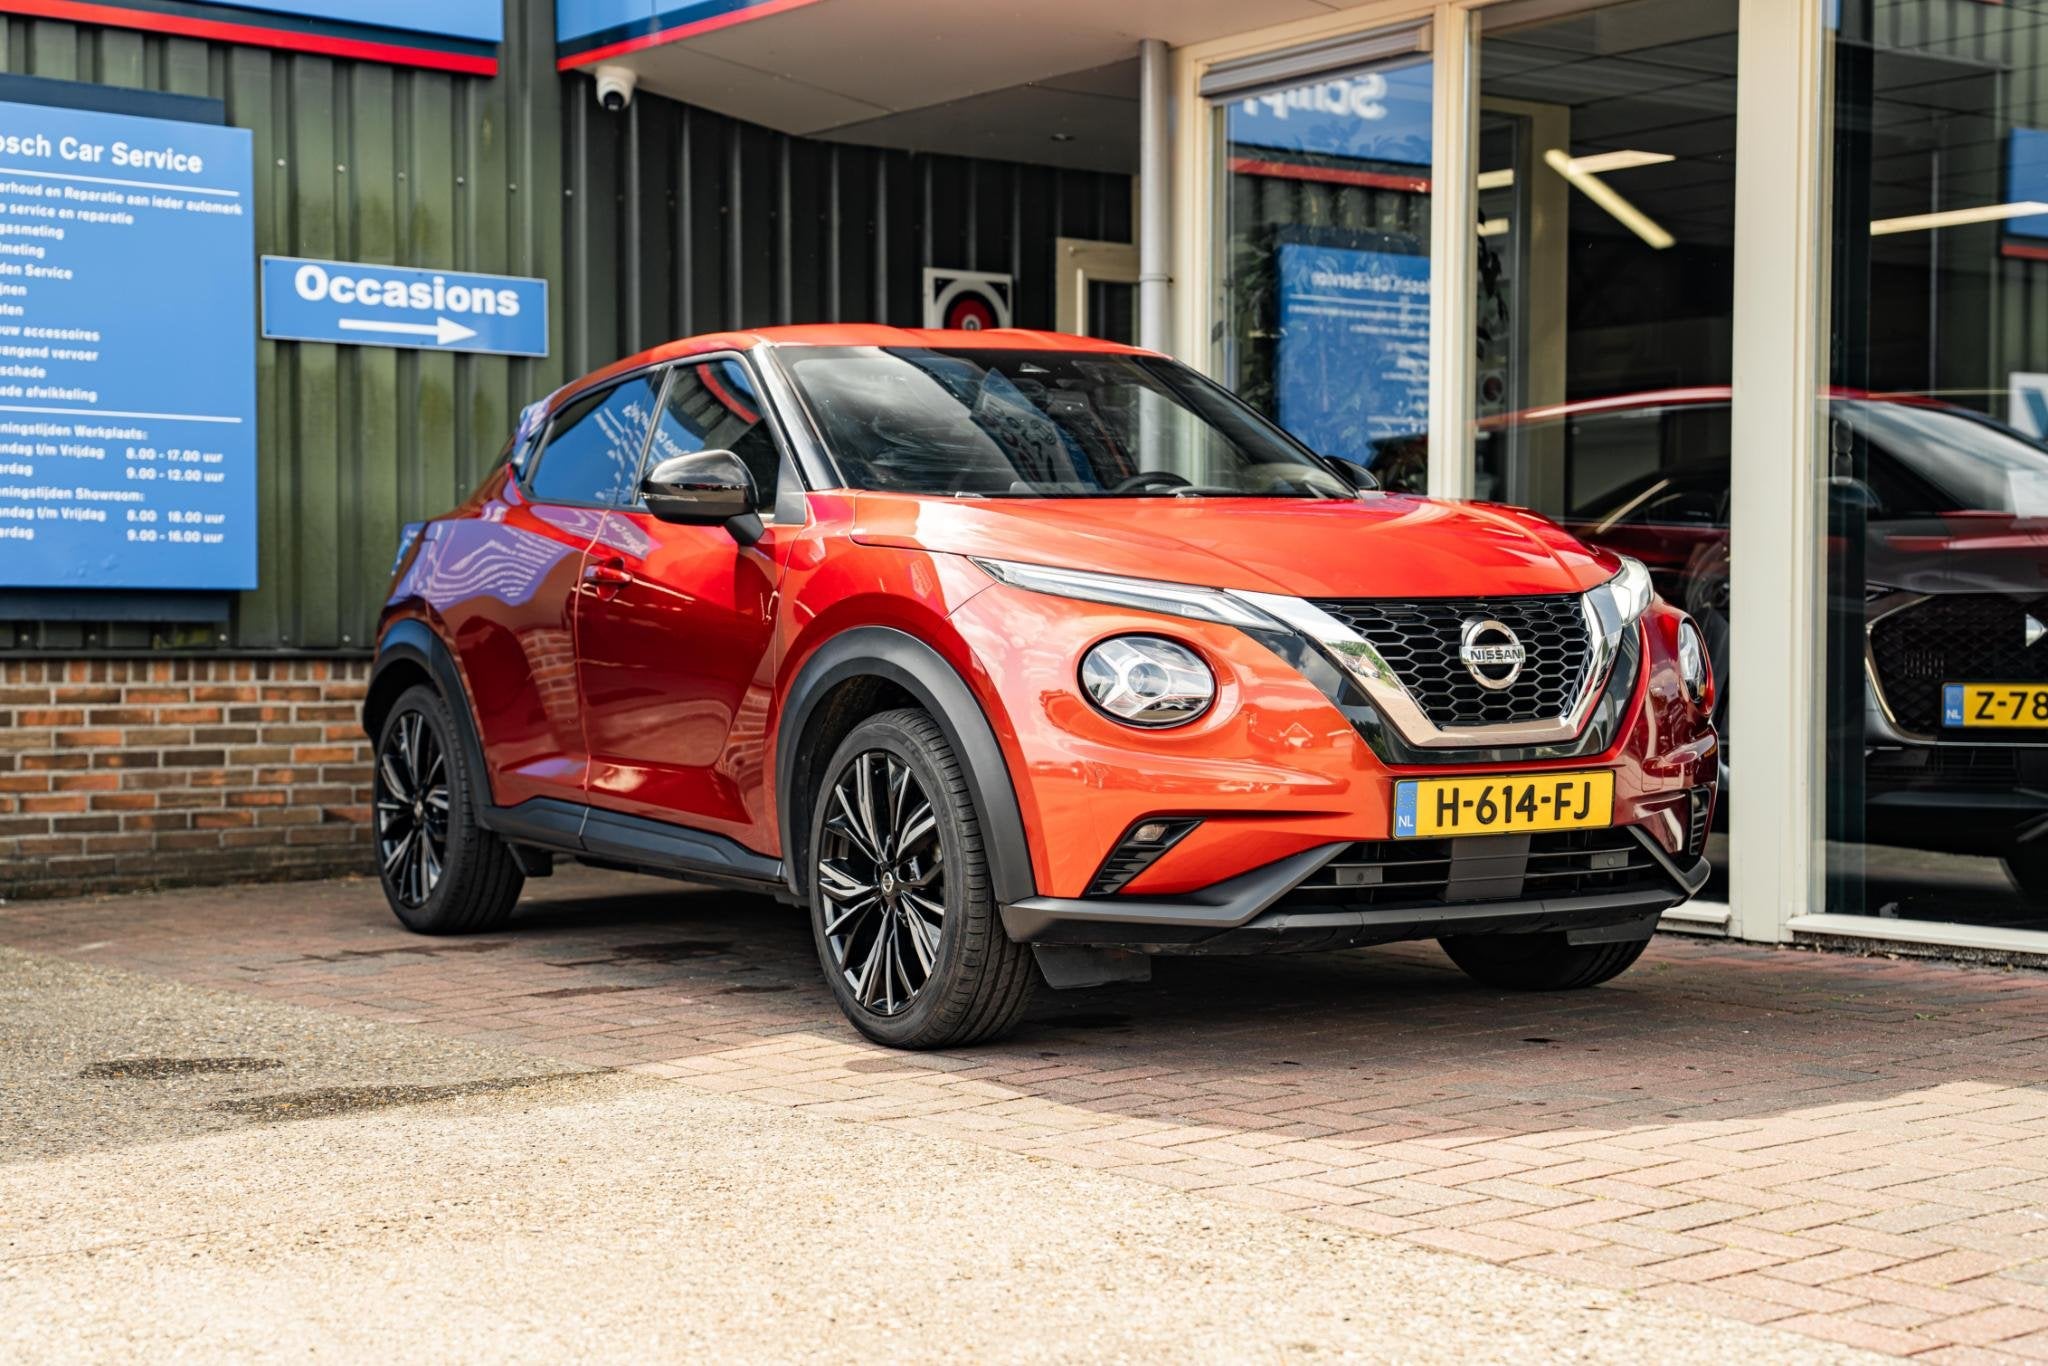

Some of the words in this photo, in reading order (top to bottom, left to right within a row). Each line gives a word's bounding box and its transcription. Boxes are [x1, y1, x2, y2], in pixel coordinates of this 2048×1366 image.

[59, 136, 104, 163] Car
[111, 142, 203, 174] Service
[45, 187, 62, 198] en
[64, 186, 125, 204] Reparatie
[127, 194, 150, 207] aan
[10, 204, 56, 218] service
[58, 208, 75, 220] en
[77, 209, 134, 225] reparatie
[24, 263, 74, 280] Service
[294, 264, 521, 317] Occasions
[23, 326, 101, 342] accessoires
[51, 348, 99, 362] vervoer
[60, 443, 106, 460] Vrijdag
[202, 453, 224, 464] uur
[203, 472, 225, 483] uur
[61, 506, 107, 523] Vrijdag
[204, 513, 226, 525] uur
[202, 533, 224, 544] uur
[1470, 649, 1524, 661] NISSAN
[1945, 708, 1962, 720] NL
[1398, 815, 1414, 828] NL
[1436, 781, 1591, 828] H-614-FJ
